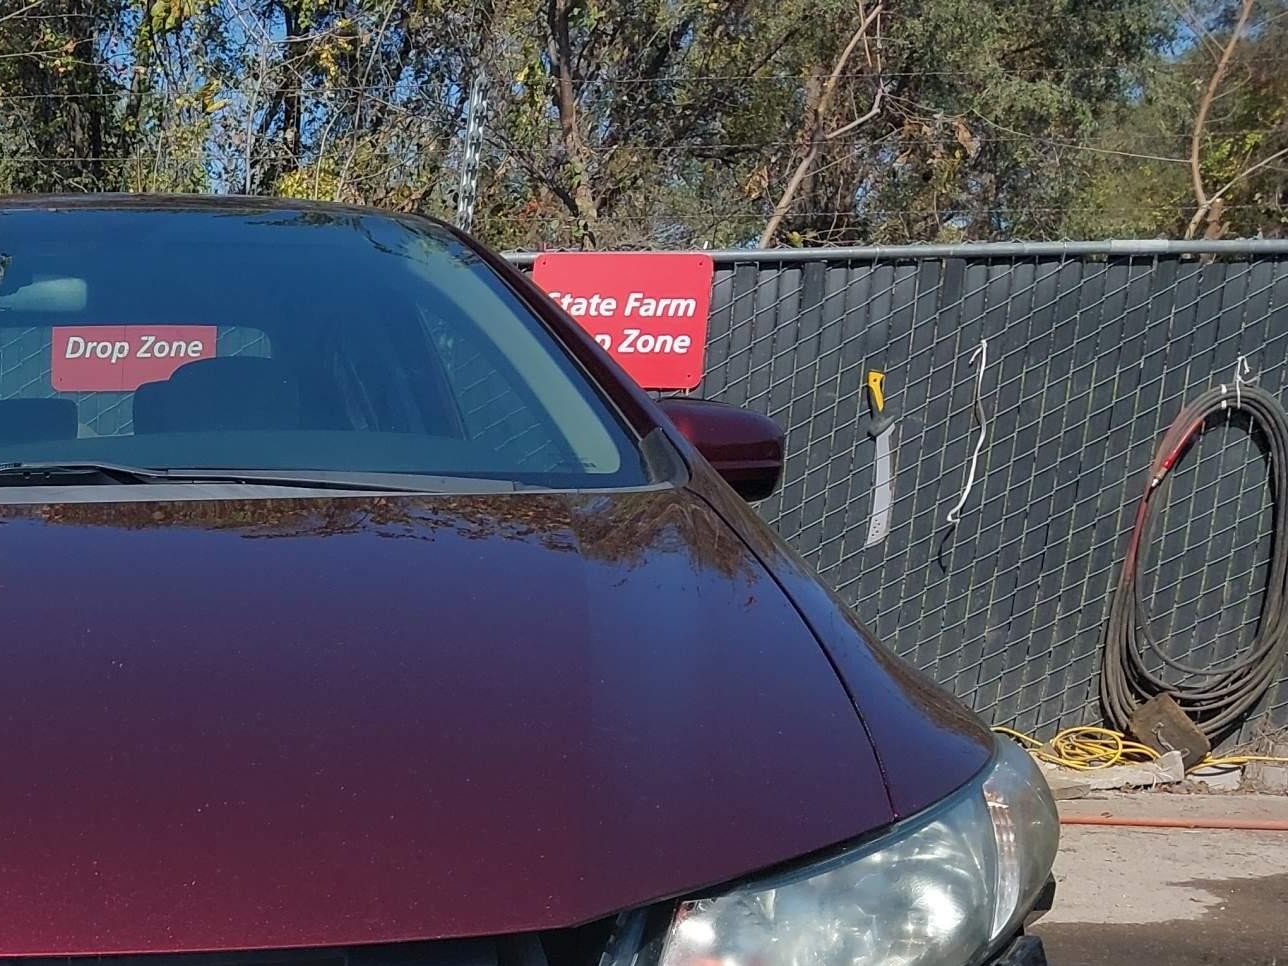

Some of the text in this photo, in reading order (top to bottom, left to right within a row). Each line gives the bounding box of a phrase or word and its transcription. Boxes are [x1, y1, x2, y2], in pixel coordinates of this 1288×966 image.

[623, 292, 697, 317] Farm
[65, 335, 203, 364] Drop Zone
[617, 328, 691, 353] Zone
